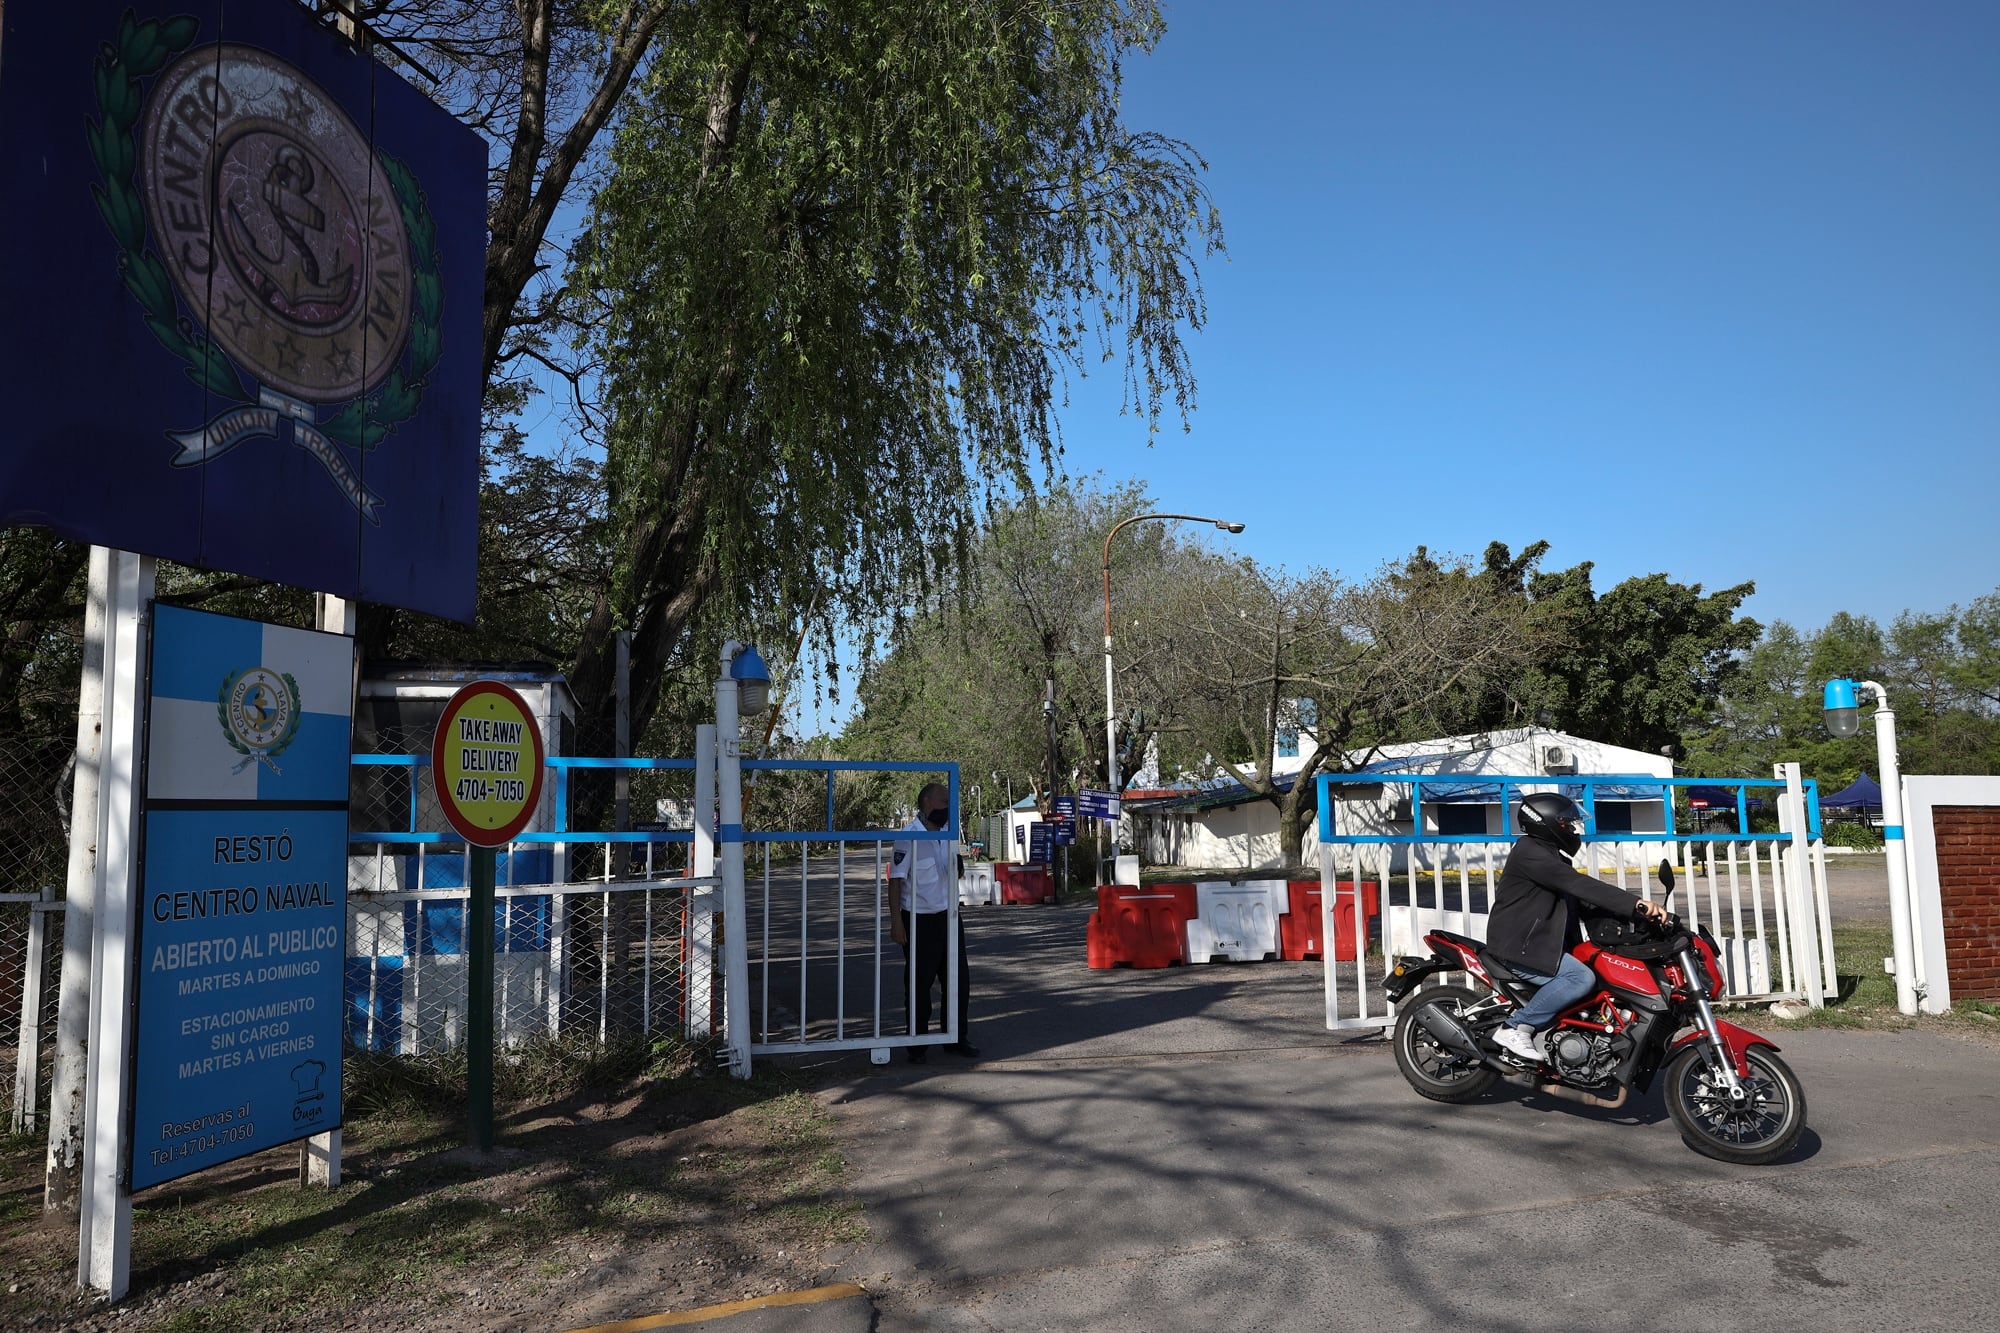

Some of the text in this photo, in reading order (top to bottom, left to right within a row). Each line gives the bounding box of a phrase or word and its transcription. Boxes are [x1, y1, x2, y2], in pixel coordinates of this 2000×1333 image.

[161, 76, 398, 343] CENTRO NAVAL
[207, 411, 271, 447] UNION
[298, 427, 371, 510] TRABAJO
[232, 682, 287, 728] CENTRO NAVAL
[459, 718, 523, 744] TAKE AWAY
[462, 748, 520, 773] DELIVERY
[456, 779, 524, 802] 4704-7050
[214, 827, 293, 864] RESTÓ
[153, 881, 335, 924] CENTRO NAVAL
[151, 926, 337, 972] ABIERTO AL PUBLICO
[178, 960, 320, 996] MARTES A DOMINGO
[182, 997, 316, 1035] ESTACIONAMIENTO
[211, 1021, 289, 1050] SIN CARGO
[179, 1035, 315, 1079] MARTES A VIERNES
[161, 1101, 250, 1140] Reservas al
[292, 1105, 322, 1122] Guga
[151, 1122, 254, 1165] Tel:4704-7050
